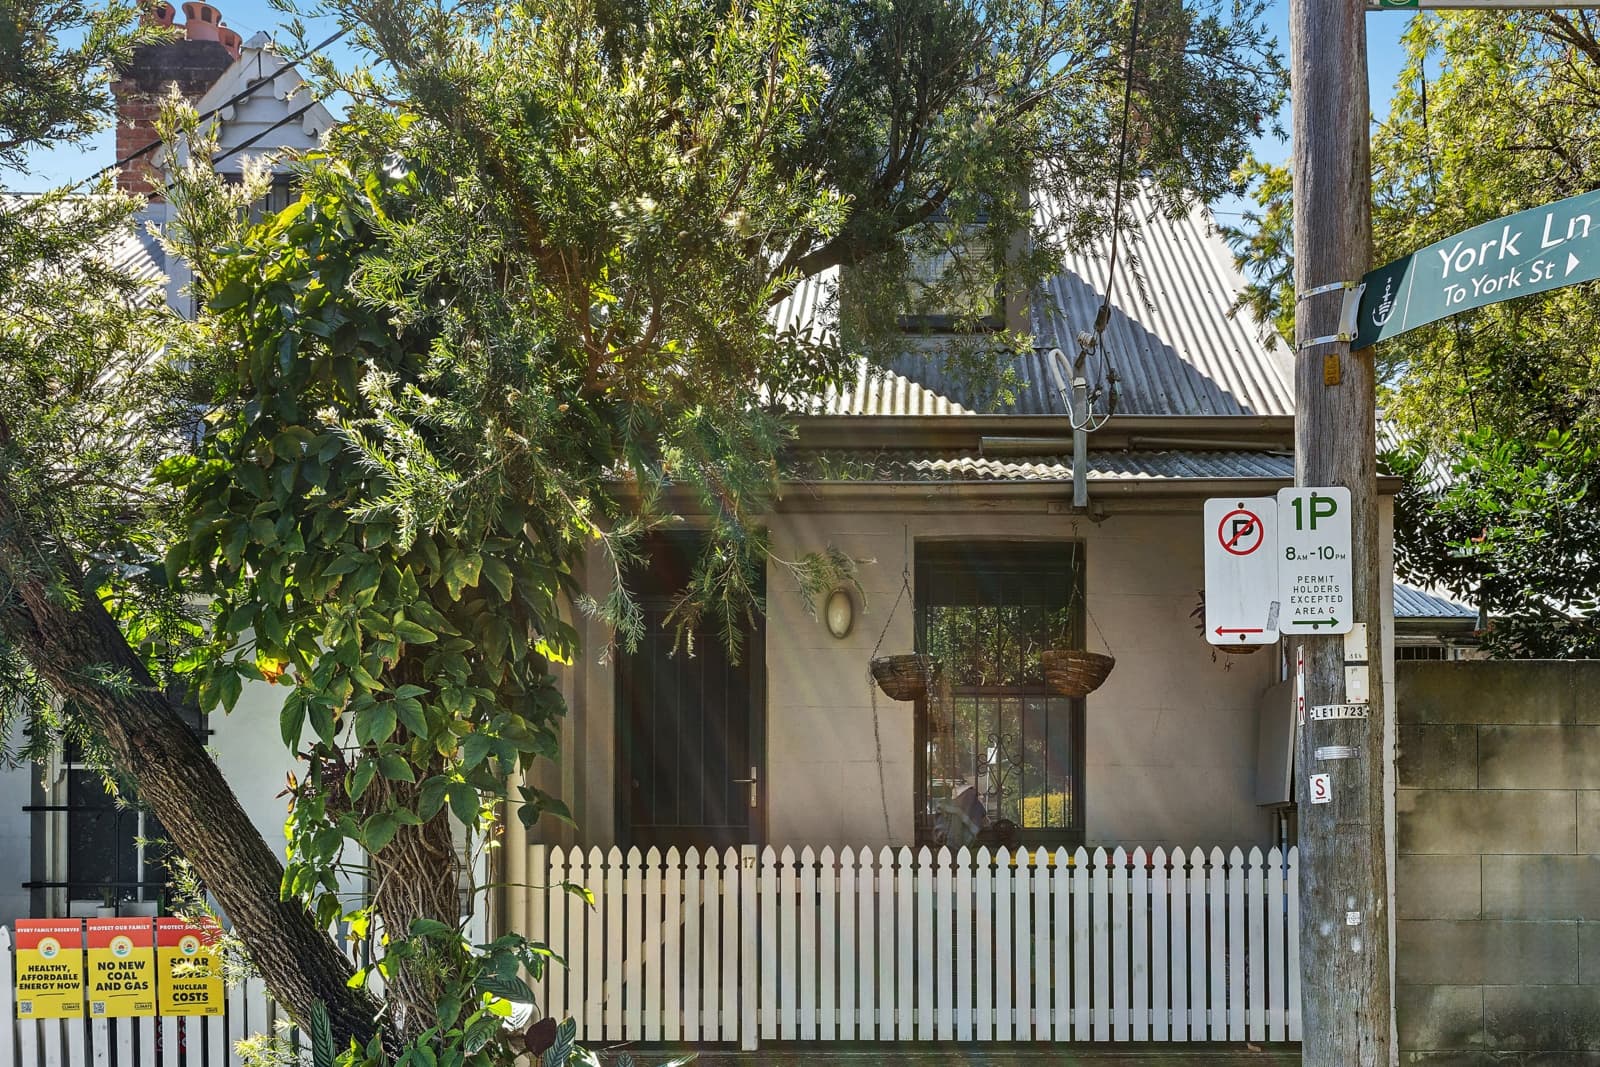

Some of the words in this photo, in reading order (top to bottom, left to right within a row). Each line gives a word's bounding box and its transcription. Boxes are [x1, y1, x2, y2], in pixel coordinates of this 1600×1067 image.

[1438, 224, 1524, 279] York
[1540, 212, 1592, 249] Ln
[1443, 283, 1466, 307] To
[1471, 267, 1523, 298] York
[1529, 259, 1556, 284] St
[1291, 496, 1338, 531] 1P
[1232, 519, 1254, 546] P
[1297, 575, 1335, 584] PERMIT
[1293, 585, 1340, 594] HOLDERS
[1290, 595, 1344, 604] EXCEPTED
[1295, 607, 1324, 615] AREA
[1328, 606, 1335, 614] G
[1315, 778, 1325, 796] S
[742, 856, 756, 869] 17
[28, 964, 71, 973] HEALTHY,
[97, 961, 116, 971] NO
[118, 961, 146, 970] NEW
[107, 971, 138, 980] COAL
[57, 982, 80, 990] NOW
[95, 982, 121, 991] AND
[124, 981, 149, 990] GAS
[172, 992, 209, 1001] COSTS
